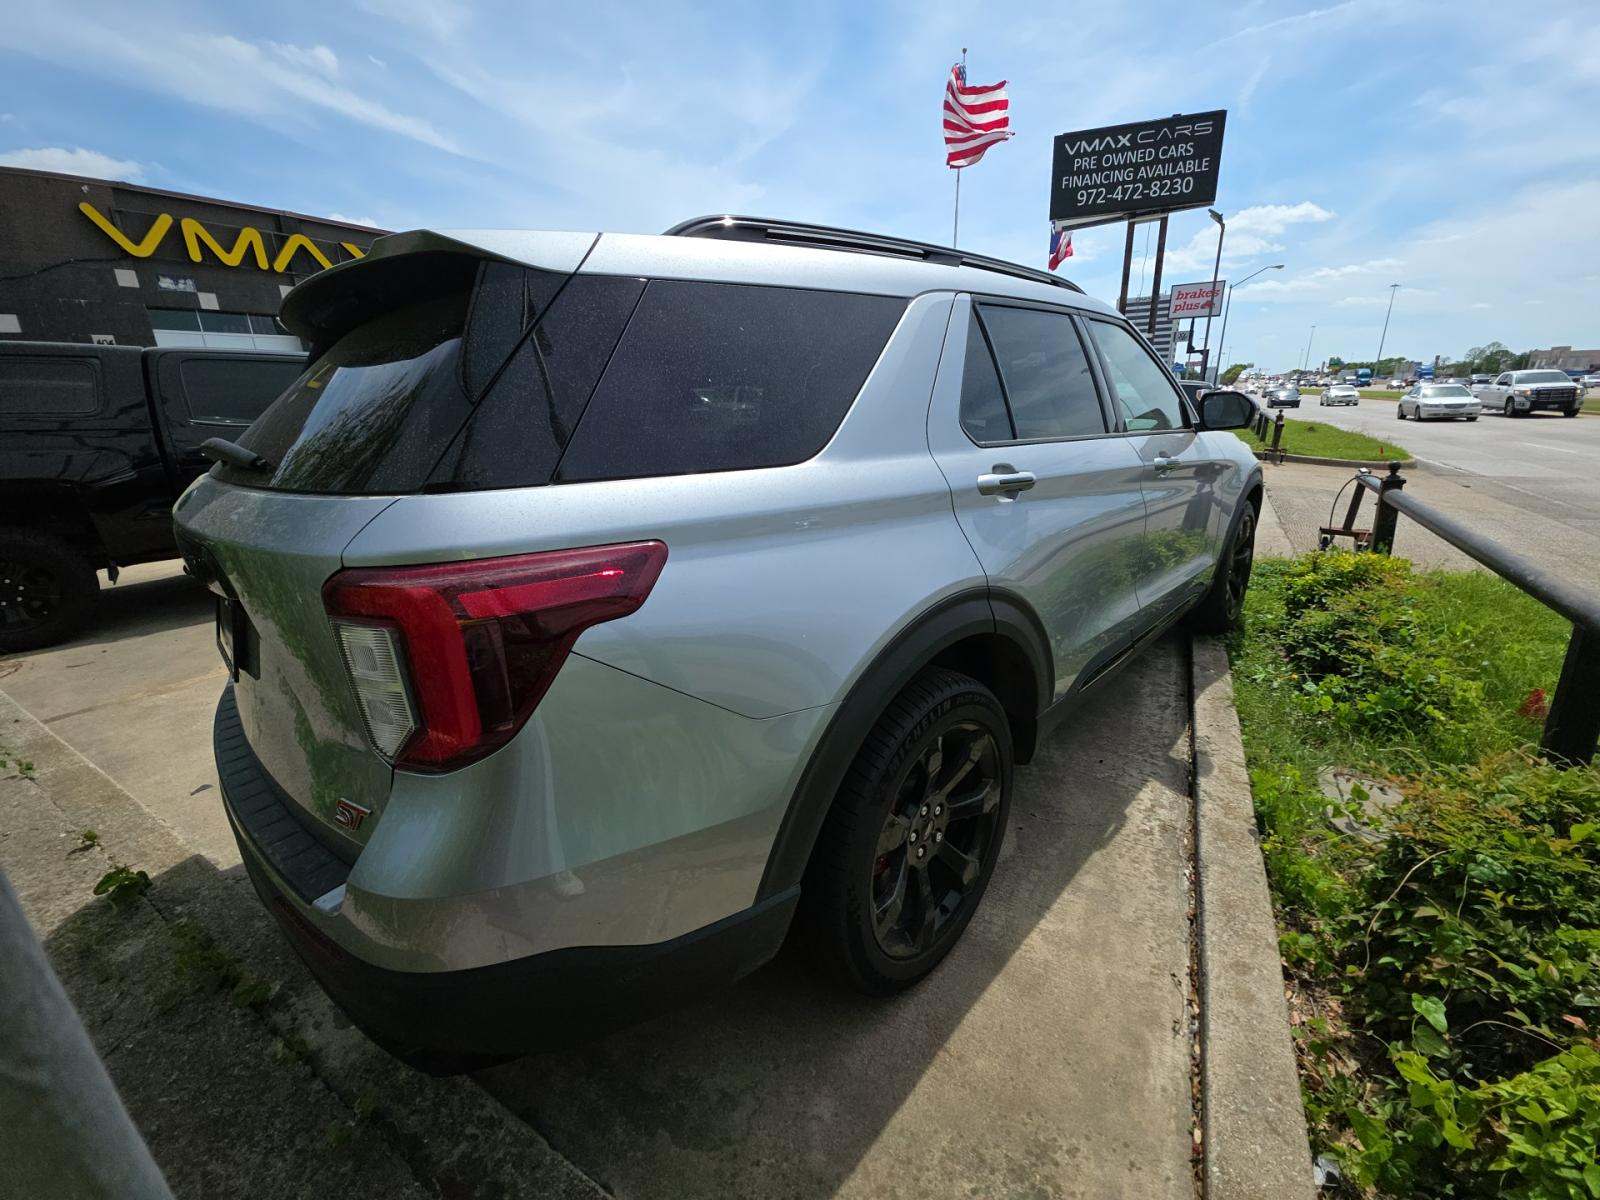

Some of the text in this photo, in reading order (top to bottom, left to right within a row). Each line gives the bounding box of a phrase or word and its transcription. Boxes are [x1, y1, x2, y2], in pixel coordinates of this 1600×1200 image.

[1065, 122, 1213, 156] VMAX CARS
[1074, 143, 1194, 171] PRE OWNED CARS
[1062, 158, 1210, 189] FINANCING AVAILABLE
[1077, 177, 1193, 206] 972-472-8230
[79, 202, 367, 273] VMA
[1173, 302, 1199, 314] plus
[1176, 288, 1221, 300] brakes
[335, 798, 371, 831] ST
